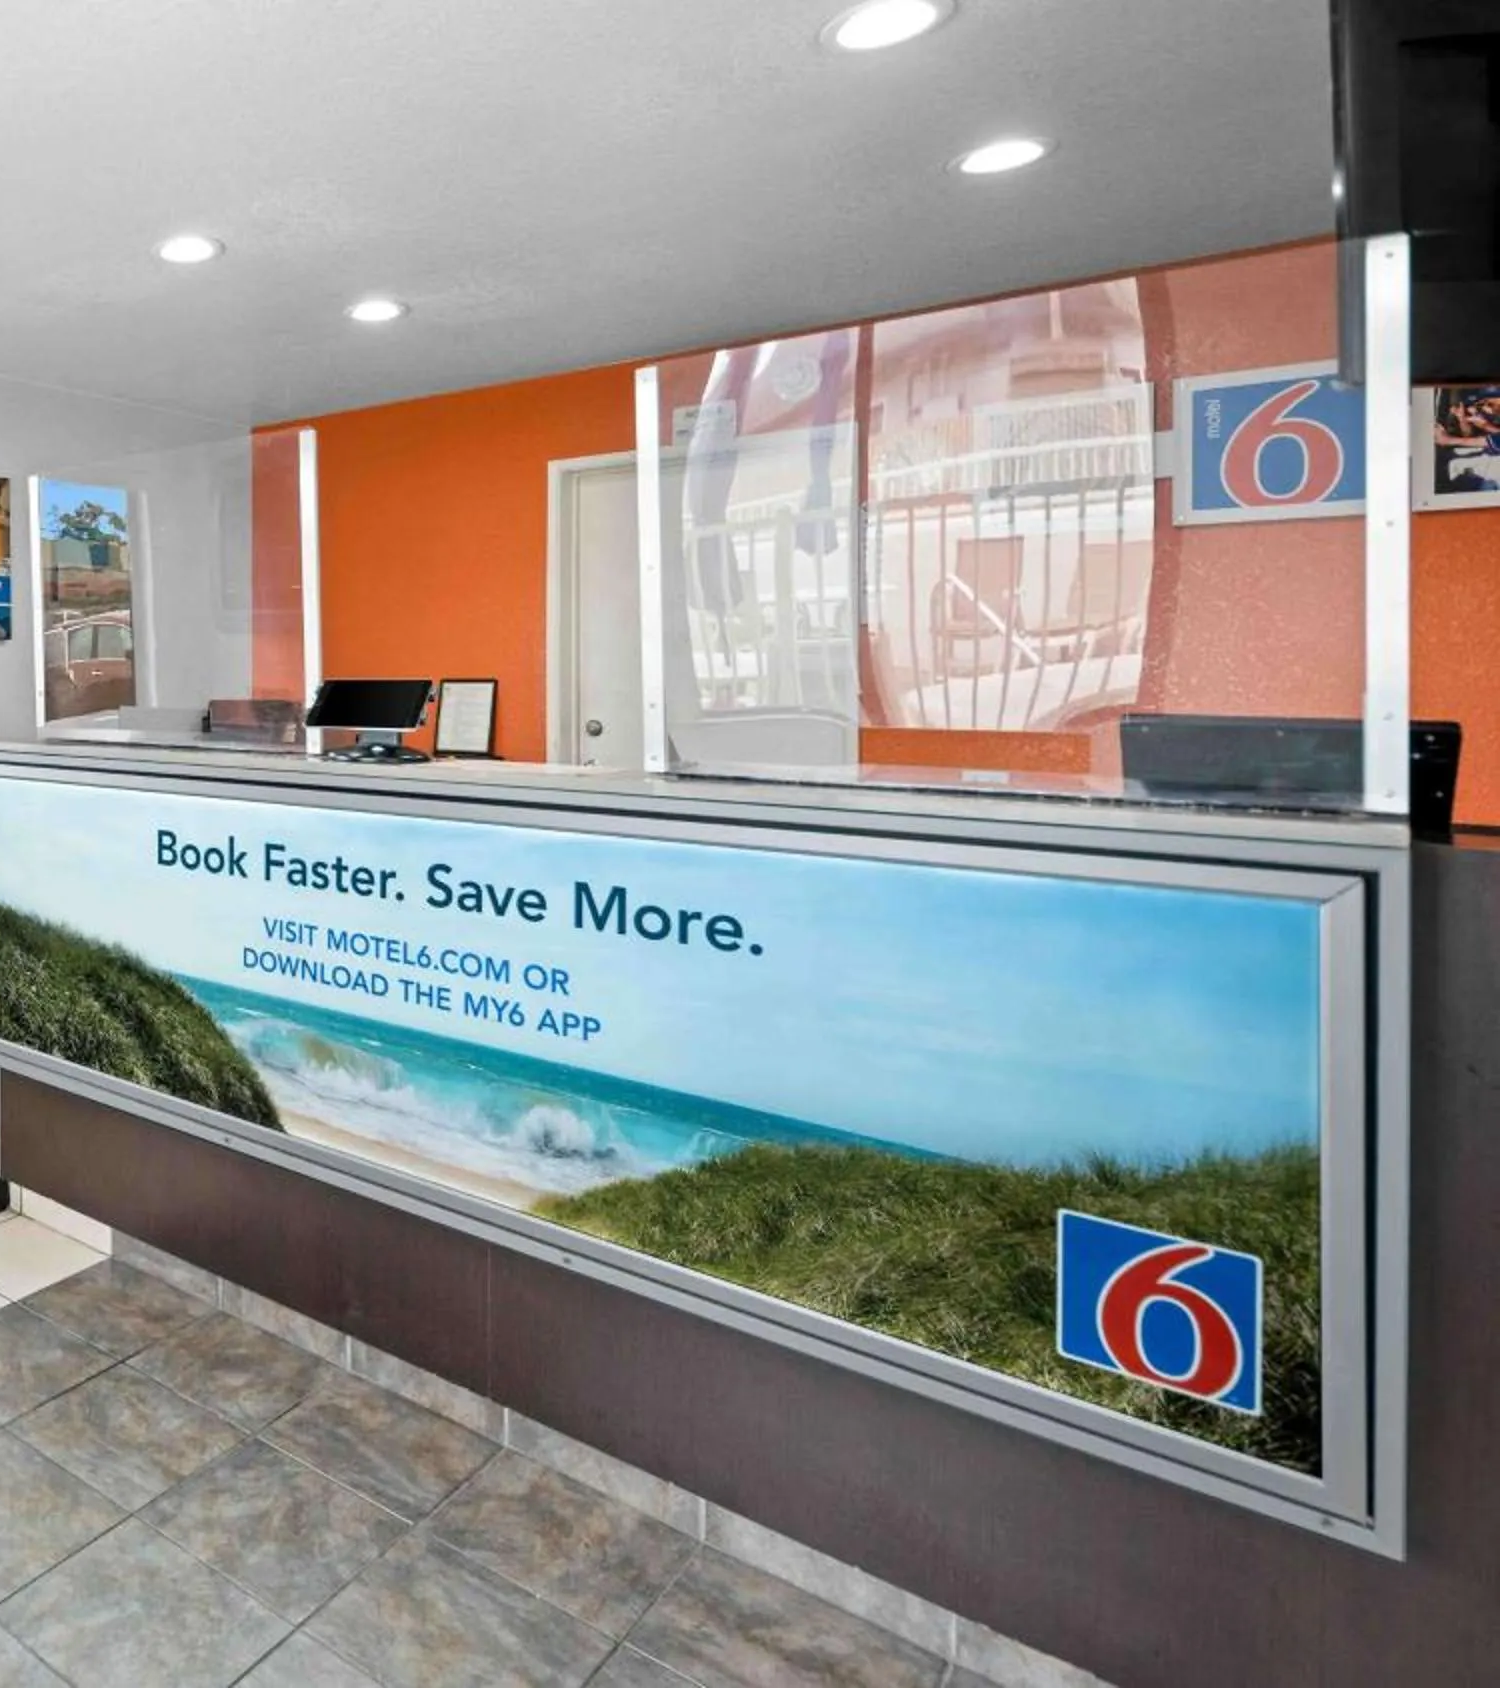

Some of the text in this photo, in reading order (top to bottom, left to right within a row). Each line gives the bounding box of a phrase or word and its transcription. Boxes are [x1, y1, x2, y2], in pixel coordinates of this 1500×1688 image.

[1205, 399, 1221, 440] motel
[1220, 380, 1344, 509] 6
[157, 829, 764, 957] Book Faster. Save More.
[243, 947, 602, 1042] DOWNLOAD THE MY6 APP
[263, 917, 570, 997] VISIT MOTEL6.COM OR
[1096, 1242, 1243, 1400] 6
